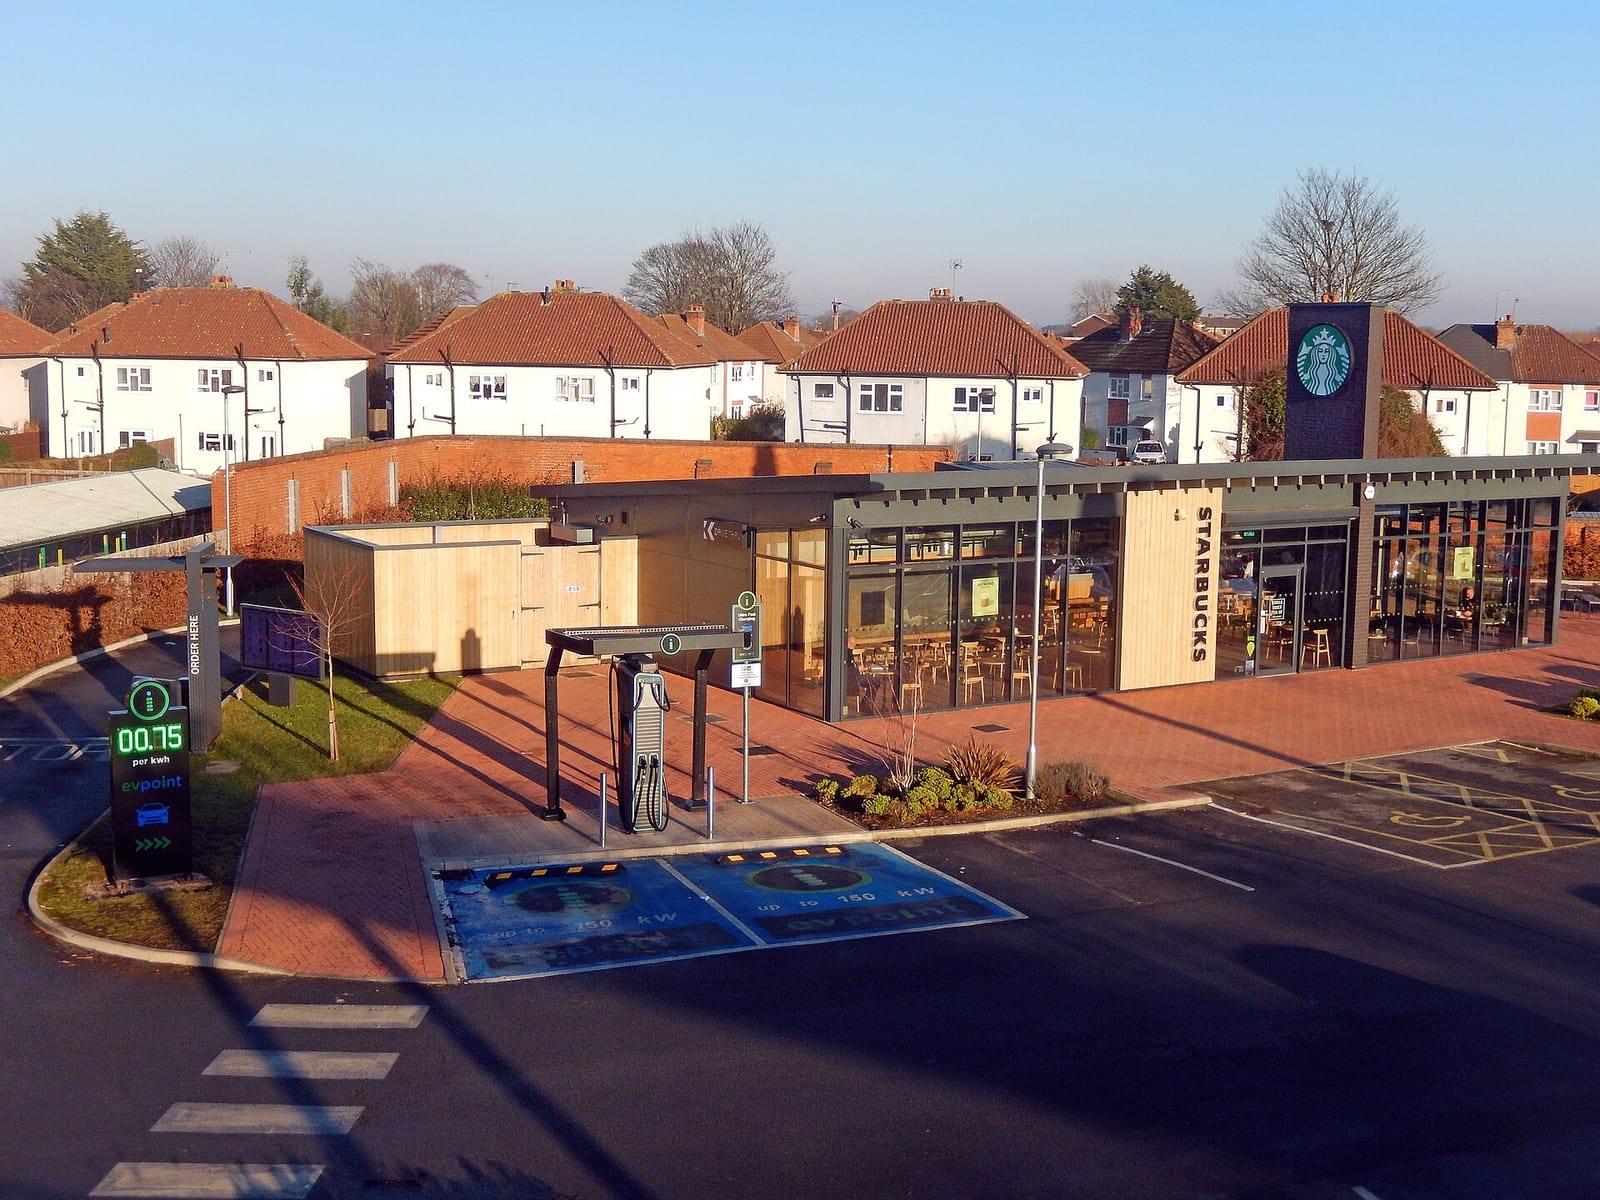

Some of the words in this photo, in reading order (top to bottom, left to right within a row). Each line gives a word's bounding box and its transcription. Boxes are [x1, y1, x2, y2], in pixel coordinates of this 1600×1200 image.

[1192, 506, 1213, 662] STARBUCKS
[189, 615, 199, 641] HERE
[190, 642, 200, 675] ORDER
[118, 725, 182, 753] 00.75
[132, 758, 148, 768] per
[150, 755, 170, 765] kwh
[122, 775, 183, 792] evpoint
[757, 903, 781, 912] up
[799, 899, 818, 907] to
[837, 893, 876, 903] 150
[527, 926, 546, 935] to
[577, 919, 613, 931] 150
